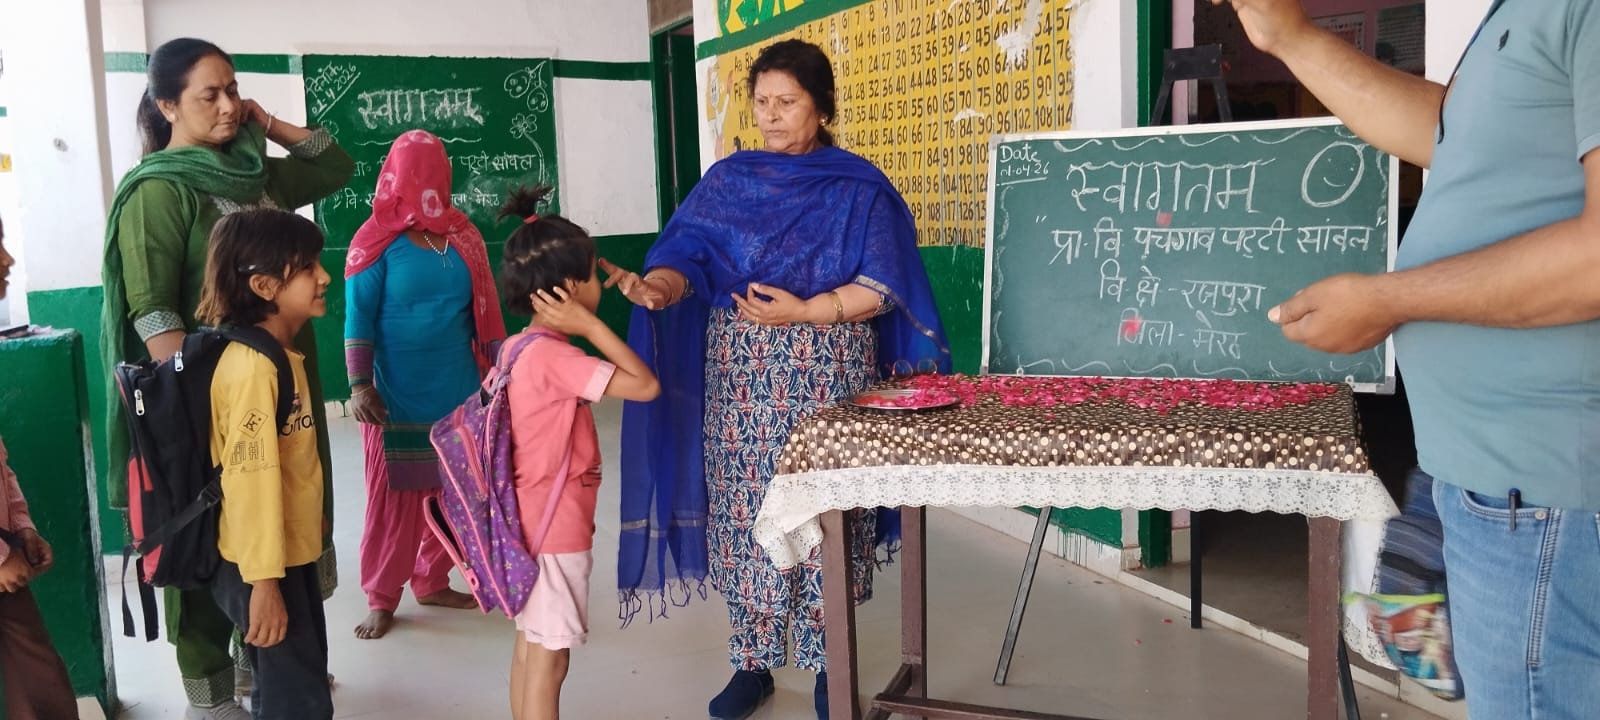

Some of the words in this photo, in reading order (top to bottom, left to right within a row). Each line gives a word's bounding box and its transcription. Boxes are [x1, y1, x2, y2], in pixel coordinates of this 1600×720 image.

[808, 24, 813, 39] 3
[818, 21, 824, 35] 4
[831, 18, 836, 34] 5
[842, 12, 848, 29] 6
[856, 10, 860, 25] 7
[869, 4, 875, 22] 8
[883, 0, 888, 19] 9
[842, 36, 850, 54] 12
[855, 32, 864, 51] 14
[868, 28, 877, 48] 16
[881, 25, 891, 45] 18
[896, 21, 906, 42] 20
[911, 17, 921, 39] 22
[926, 12, 938, 35] 24
[942, 9, 954, 31] 26
[958, 1, 972, 26] 28
[976, 0, 990, 21] 30
[842, 60, 850, 77] 18
[854, 58, 864, 75] 21
[868, 55, 879, 73] 24
[881, 52, 891, 71] 27
[896, 49, 907, 69] 30
[911, 44, 922, 65] 33
[925, 40, 938, 61] 36
[941, 35, 954, 57] 39
[975, 26, 991, 47] 45
[1056, 7, 1073, 31] 57
[843, 85, 852, 103] 24
[856, 82, 865, 100] 28
[869, 79, 879, 98] 32
[882, 76, 893, 97] 36
[896, 75, 907, 95] 40
[910, 70, 923, 91] 44
[925, 67, 937, 88] 48
[942, 63, 954, 83] 52
[958, 60, 973, 82] 56
[976, 57, 990, 78] 60
[1035, 43, 1052, 66] 72
[844, 107, 853, 125] 30
[856, 105, 866, 124] 35
[868, 103, 879, 123] 40
[882, 102, 894, 122] 45
[897, 100, 908, 120] 50
[911, 98, 923, 118] 55
[927, 95, 938, 115] 60
[942, 91, 956, 113] 65
[958, 90, 972, 109] 70
[977, 87, 991, 107] 75
[995, 82, 1009, 105] 80
[1014, 79, 1030, 101] 85
[1037, 75, 1052, 99] 90
[856, 129, 866, 148] 42
[869, 129, 879, 149] 48
[883, 127, 894, 146] 54
[897, 125, 908, 145] 60
[912, 122, 923, 144] 66
[927, 121, 938, 141] 72
[944, 119, 955, 139] 78
[960, 116, 973, 138] 84
[978, 114, 993, 135] 90
[996, 111, 1011, 134] 96
[1014, 108, 1031, 132] 102
[1035, 105, 1053, 130] 108
[1057, 102, 1073, 127] 114
[883, 152, 894, 170] 63
[897, 151, 908, 171] 70
[912, 150, 922, 170] 77
[927, 147, 940, 168] 84
[943, 146, 954, 167] 91
[959, 144, 973, 166] 98
[1000, 142, 1041, 163] Date
[898, 176, 910, 195] 80
[912, 176, 923, 194] 88
[926, 174, 940, 194] 96
[943, 174, 957, 195] 104
[959, 173, 973, 195] 112
[911, 202, 922, 220] 99
[927, 202, 941, 221] 108
[959, 201, 974, 221] 126
